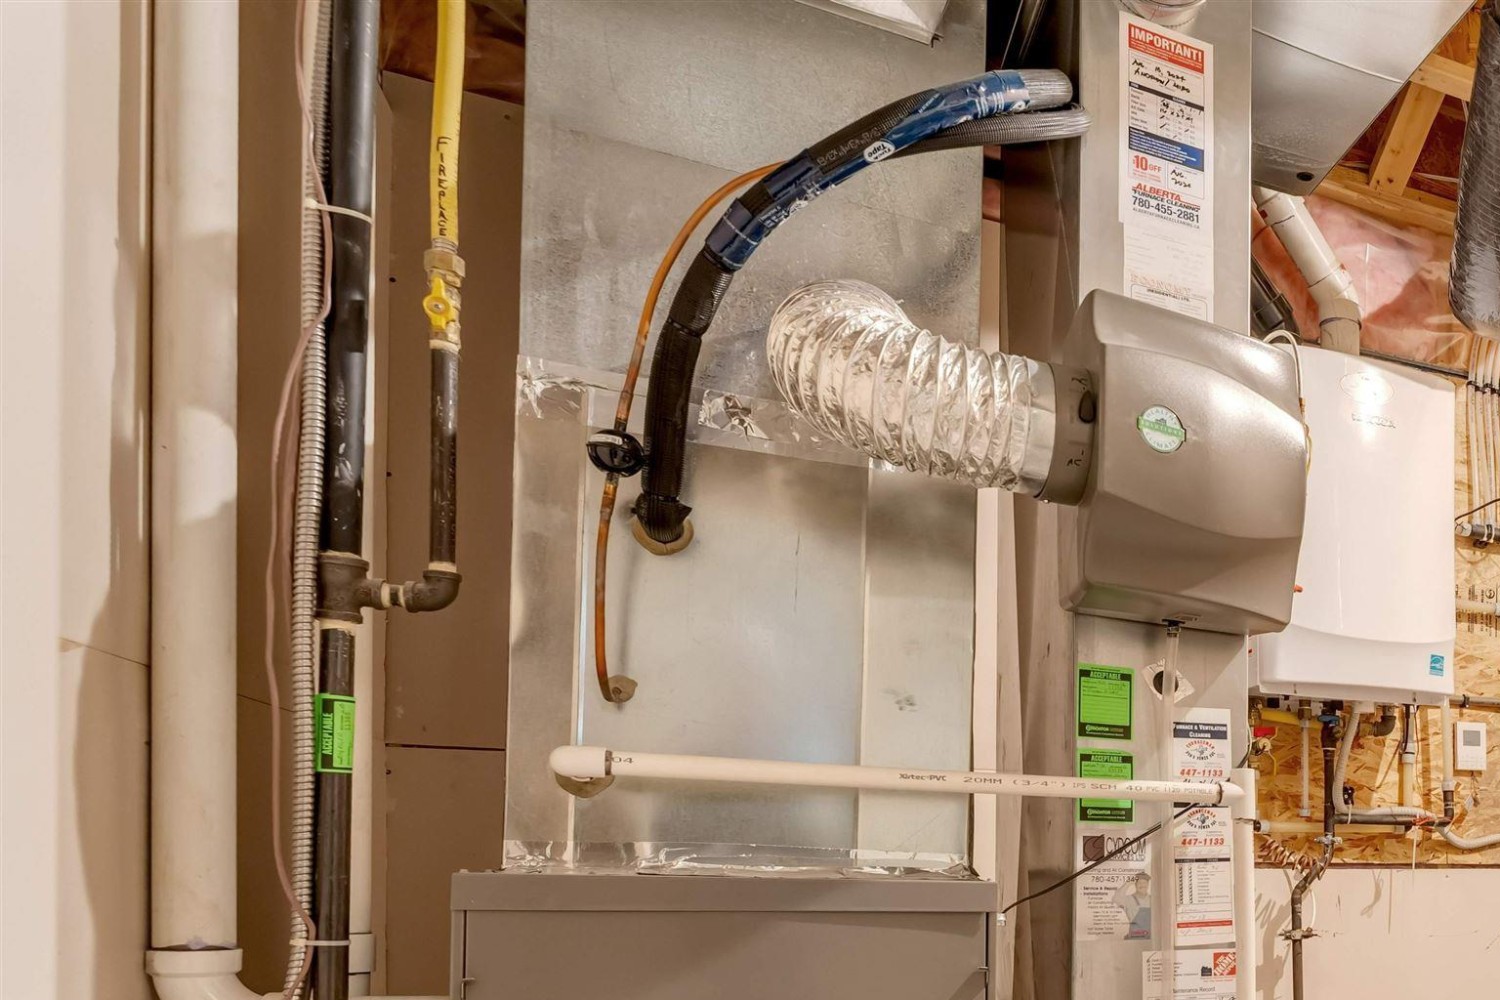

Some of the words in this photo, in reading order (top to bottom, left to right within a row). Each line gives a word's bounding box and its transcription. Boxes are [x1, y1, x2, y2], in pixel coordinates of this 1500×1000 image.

[1130, 26, 1203, 62] IMPORTANT!
[865, 141, 887, 159] Tape
[436, 136, 452, 237] FIREPLACE
[1136, 183, 1181, 201] ALBERTA
[1133, 189, 1165, 203] FURNACE
[1166, 198, 1200, 212] CLEANING
[1133, 196, 1200, 223] 780-455-2881
[1090, 671, 1121, 680] ACCEPTABLE
[321, 712, 333, 755] ACCEPTABLE
[1091, 755, 1122, 764] ACCEPTABLE
[963, 776, 1002, 784] 20MM
[1180, 769, 1223, 777] 447-1133
[1181, 838, 1224, 846] 447-1133
